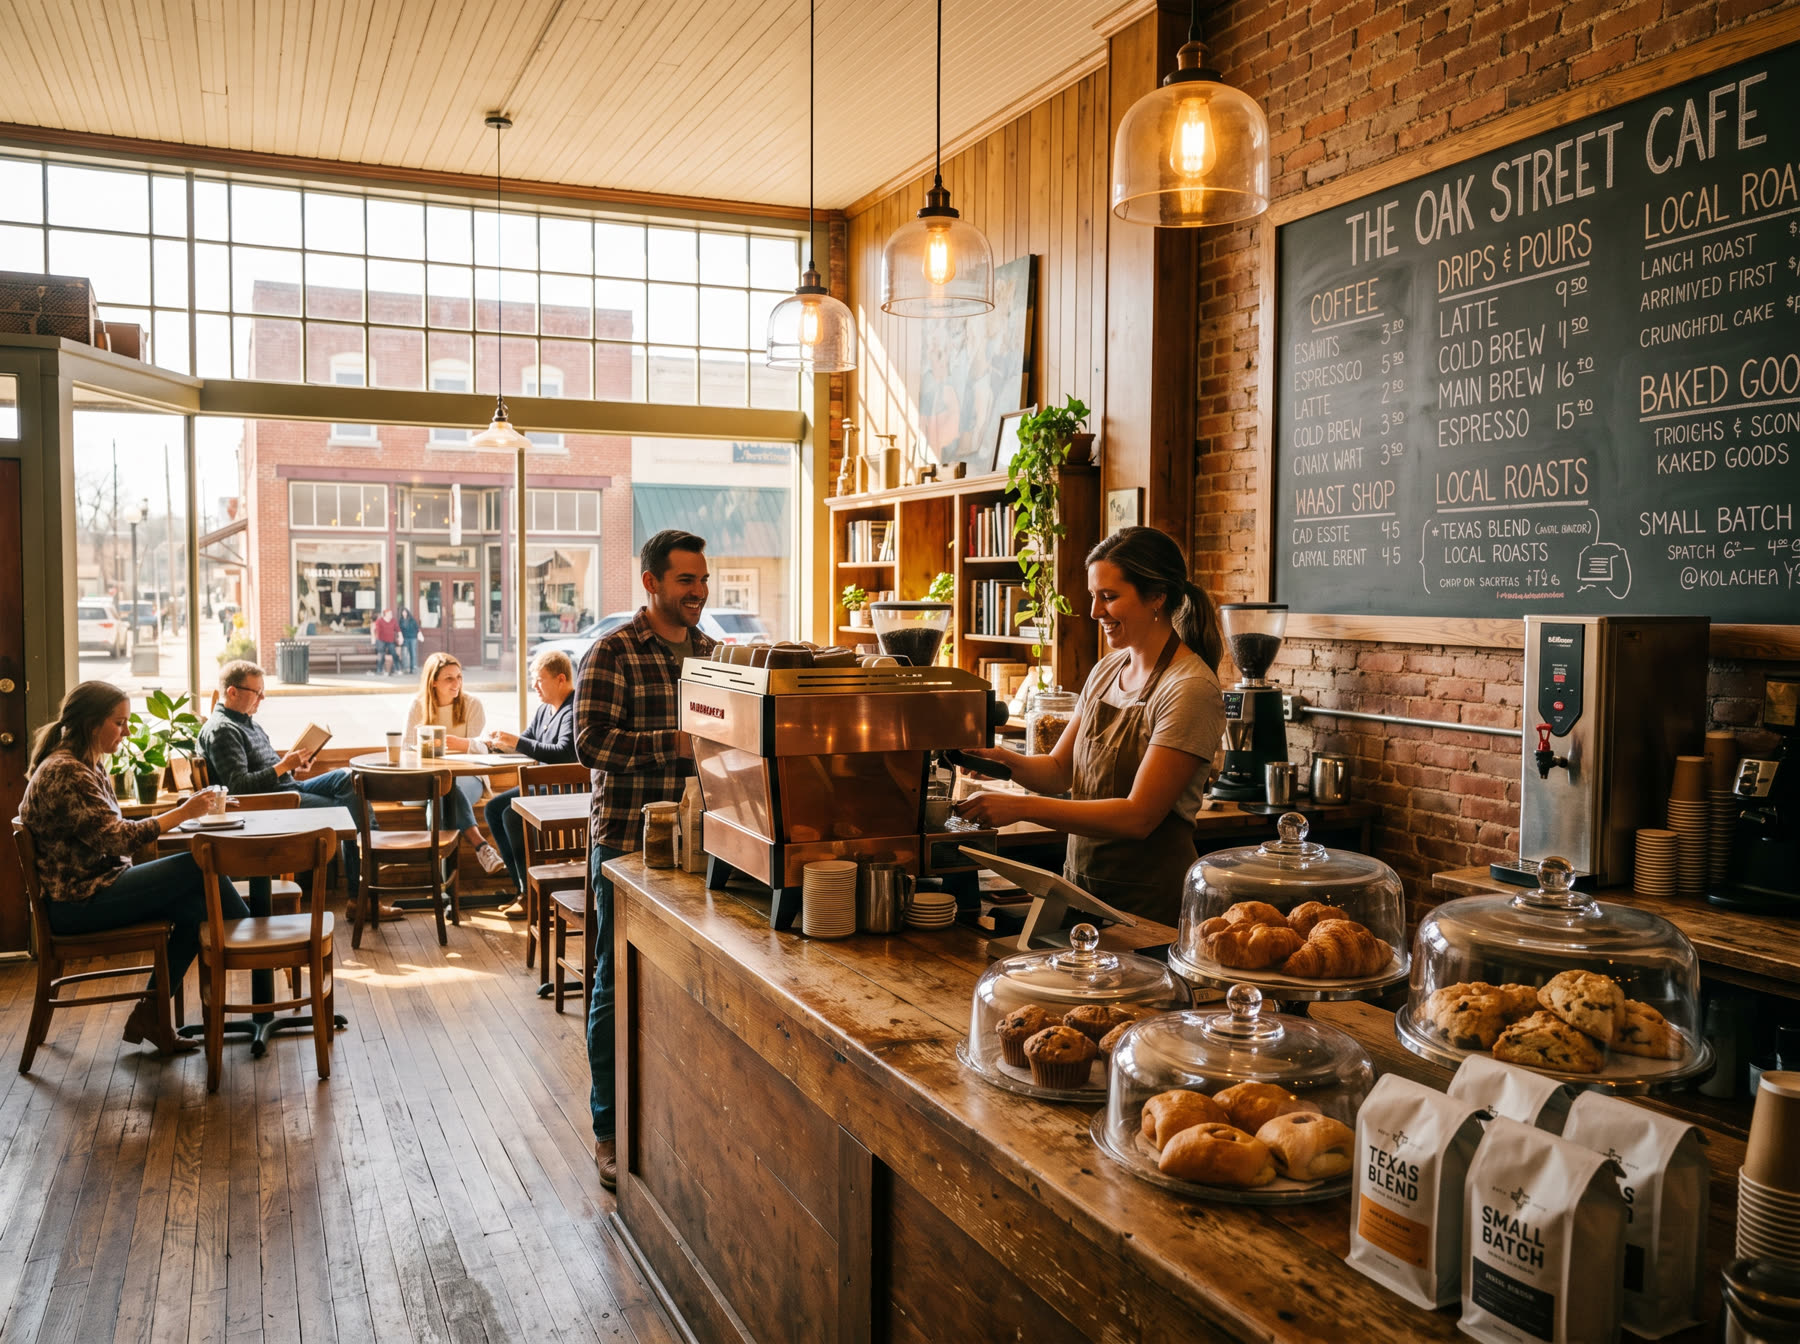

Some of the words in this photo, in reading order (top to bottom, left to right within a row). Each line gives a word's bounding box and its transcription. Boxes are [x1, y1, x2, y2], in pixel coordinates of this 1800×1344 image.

[1346, 200, 1399, 266] THE
[1415, 174, 1475, 245] OAK
[1490, 121, 1624, 223] STREET
[1645, 71, 1767, 174] CAFE
[1645, 184, 1730, 240] LOCAL
[1741, 162, 1800, 215] ROA
[1438, 245, 1496, 294] DRIPS
[1519, 218, 1592, 272] POURS
[1641, 249, 1694, 281] LANCH
[1702, 233, 1758, 266] ROAST
[1729, 261, 1777, 292] FIRST
[1311, 277, 1379, 325] COFFEE
[1440, 297, 1498, 338] LATTE
[1733, 302, 1775, 327] CAKE
[1438, 339, 1483, 374] COLD
[1489, 324, 1545, 365] BREW
[1438, 375, 1482, 410] MAIN
[1489, 363, 1545, 402] BREW
[1640, 365, 1728, 414] BAKED
[1294, 394, 1331, 420] LATTE
[1294, 425, 1323, 448] COLD
[1328, 417, 1362, 443] BREW
[1438, 408, 1530, 447] ESPRESSO
[1657, 450, 1716, 475] KAKED
[1725, 443, 1789, 468] GOODS
[1295, 484, 1345, 516] WAAST
[1351, 480, 1396, 512] SHOP
[1436, 469, 1496, 504] LOCAL
[1505, 457, 1588, 499] ROASTS
[1292, 527, 1313, 545] CAD
[1317, 525, 1351, 543] ESSTE
[1441, 520, 1482, 540] TEXAS
[1488, 518, 1531, 538] BLEND
[1639, 509, 1706, 536] SMALL
[1717, 503, 1792, 534] BATCH
[1333, 548, 1367, 567] BRENT
[1444, 545, 1486, 564] LOCAL
[1493, 542, 1549, 563] ROASTS
[1667, 544, 1715, 560] SPATCH
[1368, 1164, 1418, 1202] BLEND
[1369, 1145, 1419, 1183] TEXAS
[1482, 1205, 1545, 1248] SMALL
[1482, 1225, 1544, 1269] BATCH
